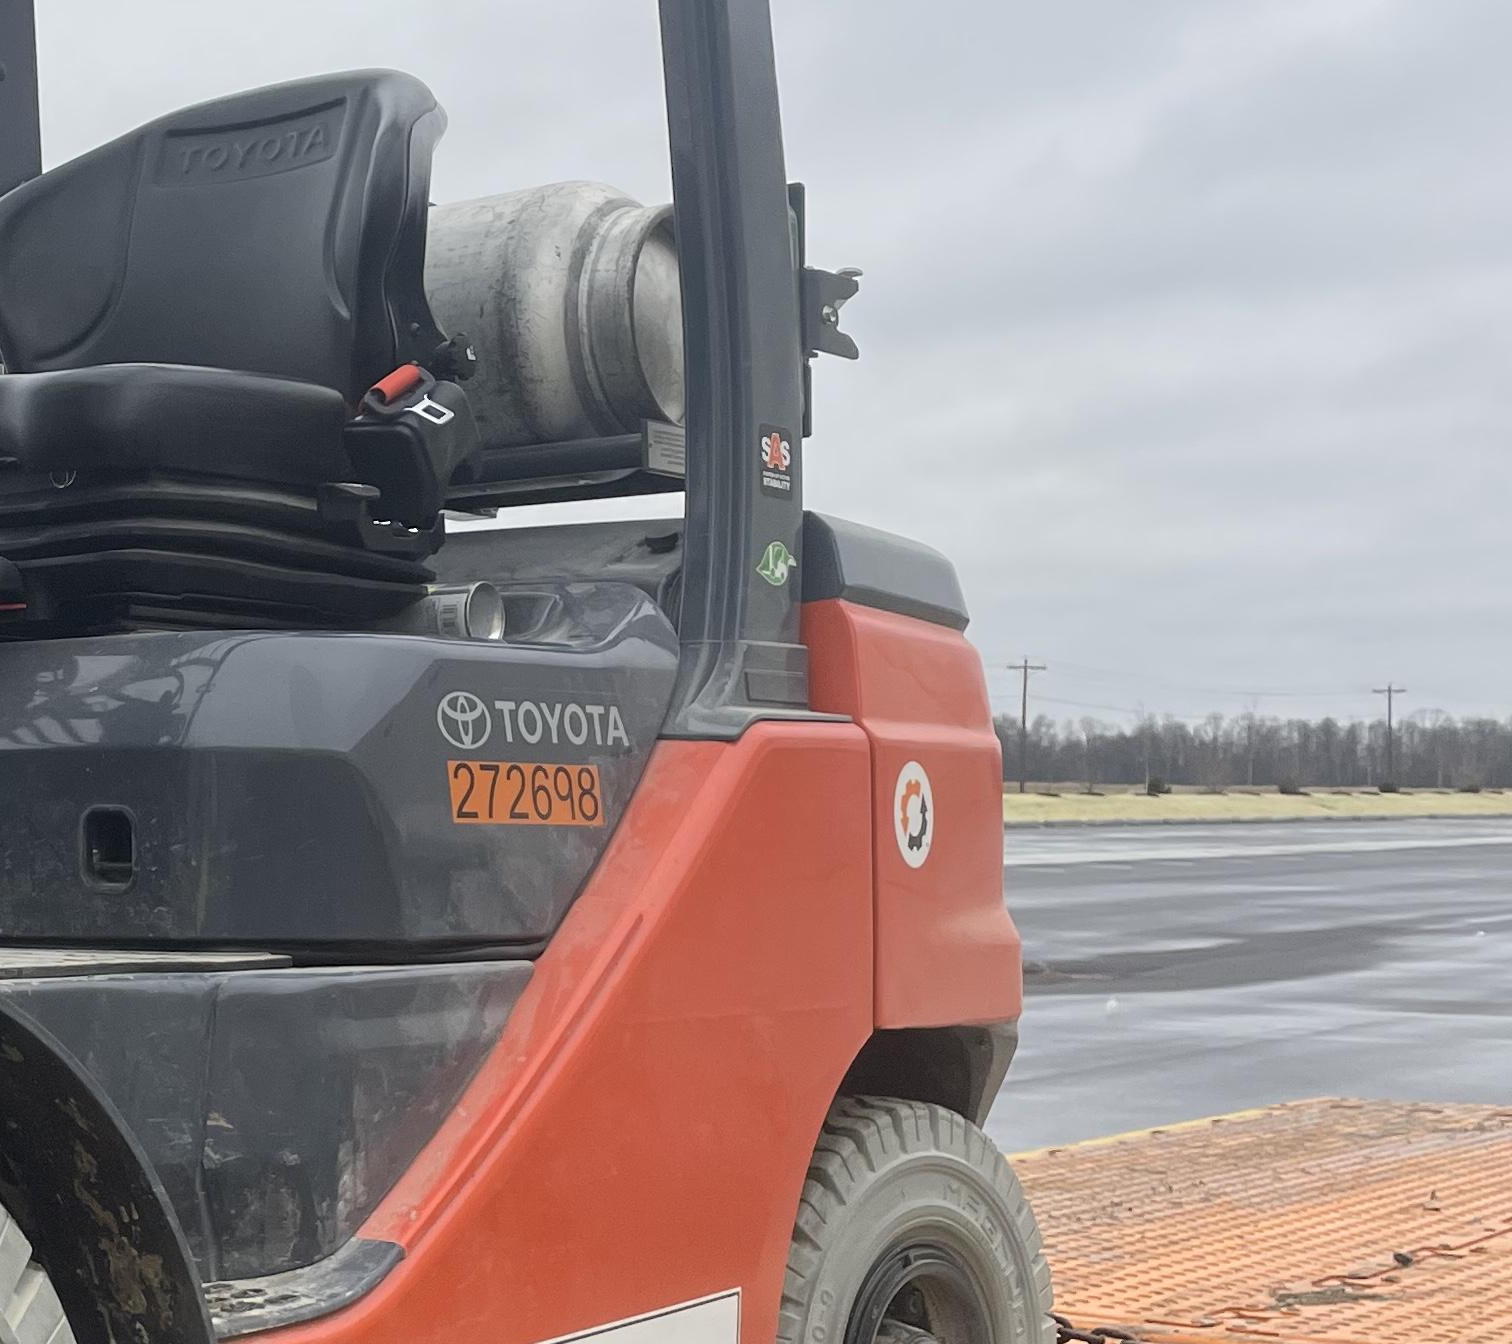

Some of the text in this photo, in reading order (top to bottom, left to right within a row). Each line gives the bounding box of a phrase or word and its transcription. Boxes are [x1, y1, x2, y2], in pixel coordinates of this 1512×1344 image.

[181, 125, 325, 175] TOYOTA
[761, 432, 791, 471] SAS
[494, 700, 630, 746] TOYOTA
[453, 762, 599, 822] 272698
